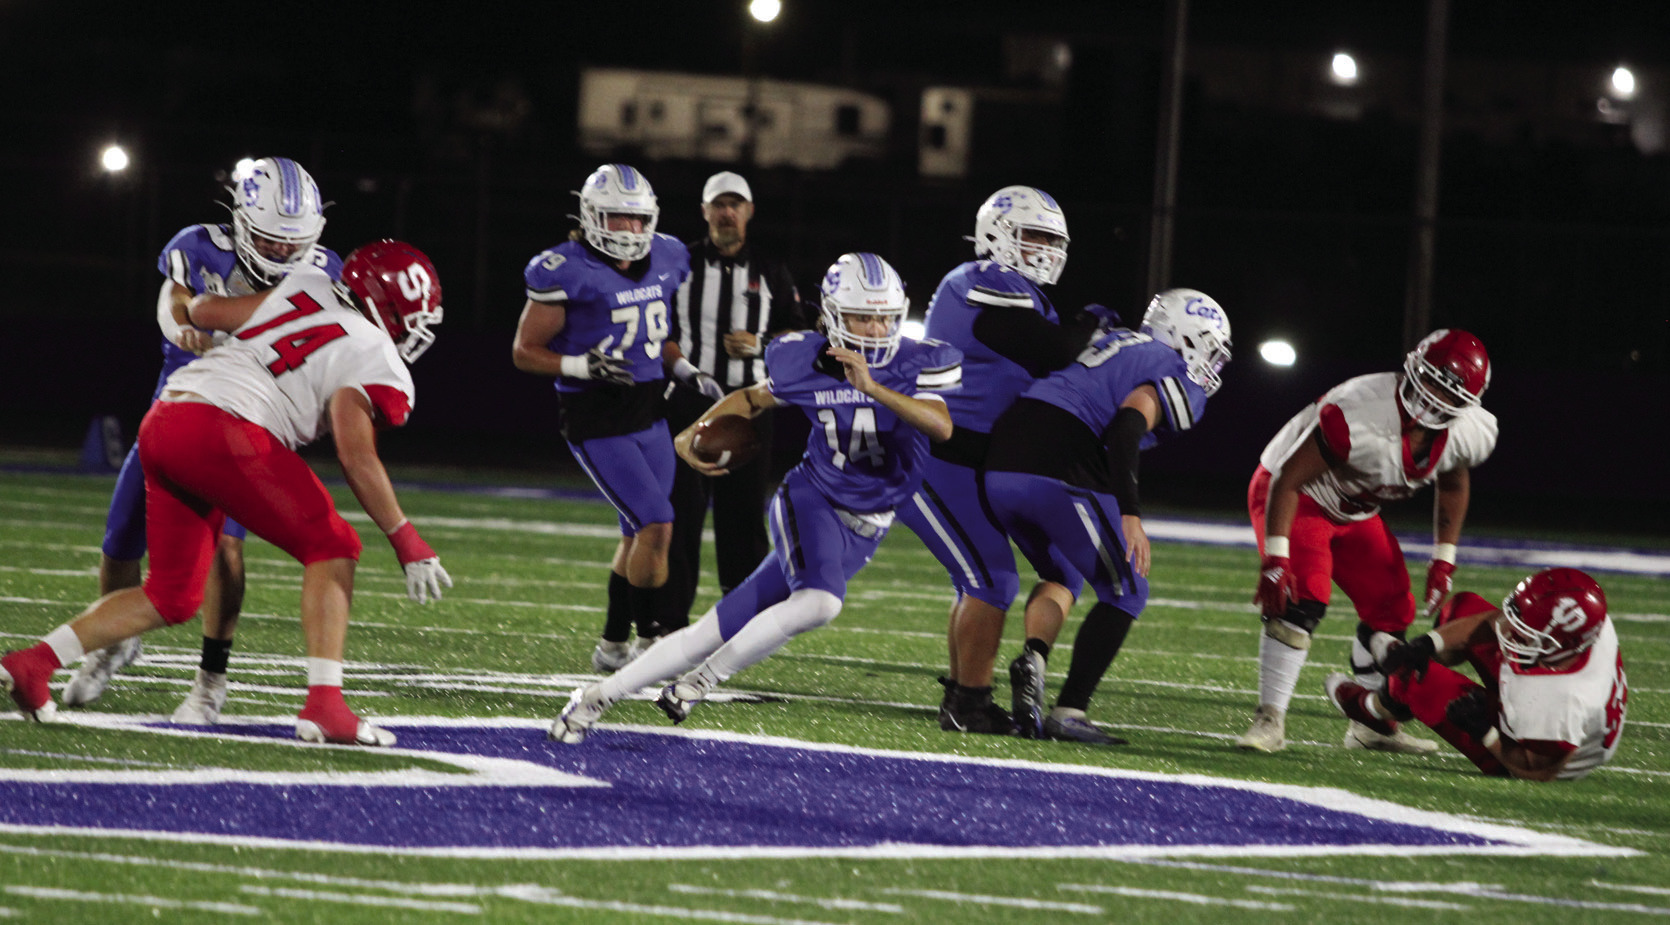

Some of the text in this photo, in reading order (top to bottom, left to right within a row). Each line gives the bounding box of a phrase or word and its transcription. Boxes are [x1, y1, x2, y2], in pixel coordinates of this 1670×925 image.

[397, 262, 432, 302] S
[615, 284, 663, 305] WILDCATS
[235, 290, 349, 379] 74
[611, 300, 669, 360] 79
[817, 407, 886, 471] 14
[1552, 597, 1588, 632] S
